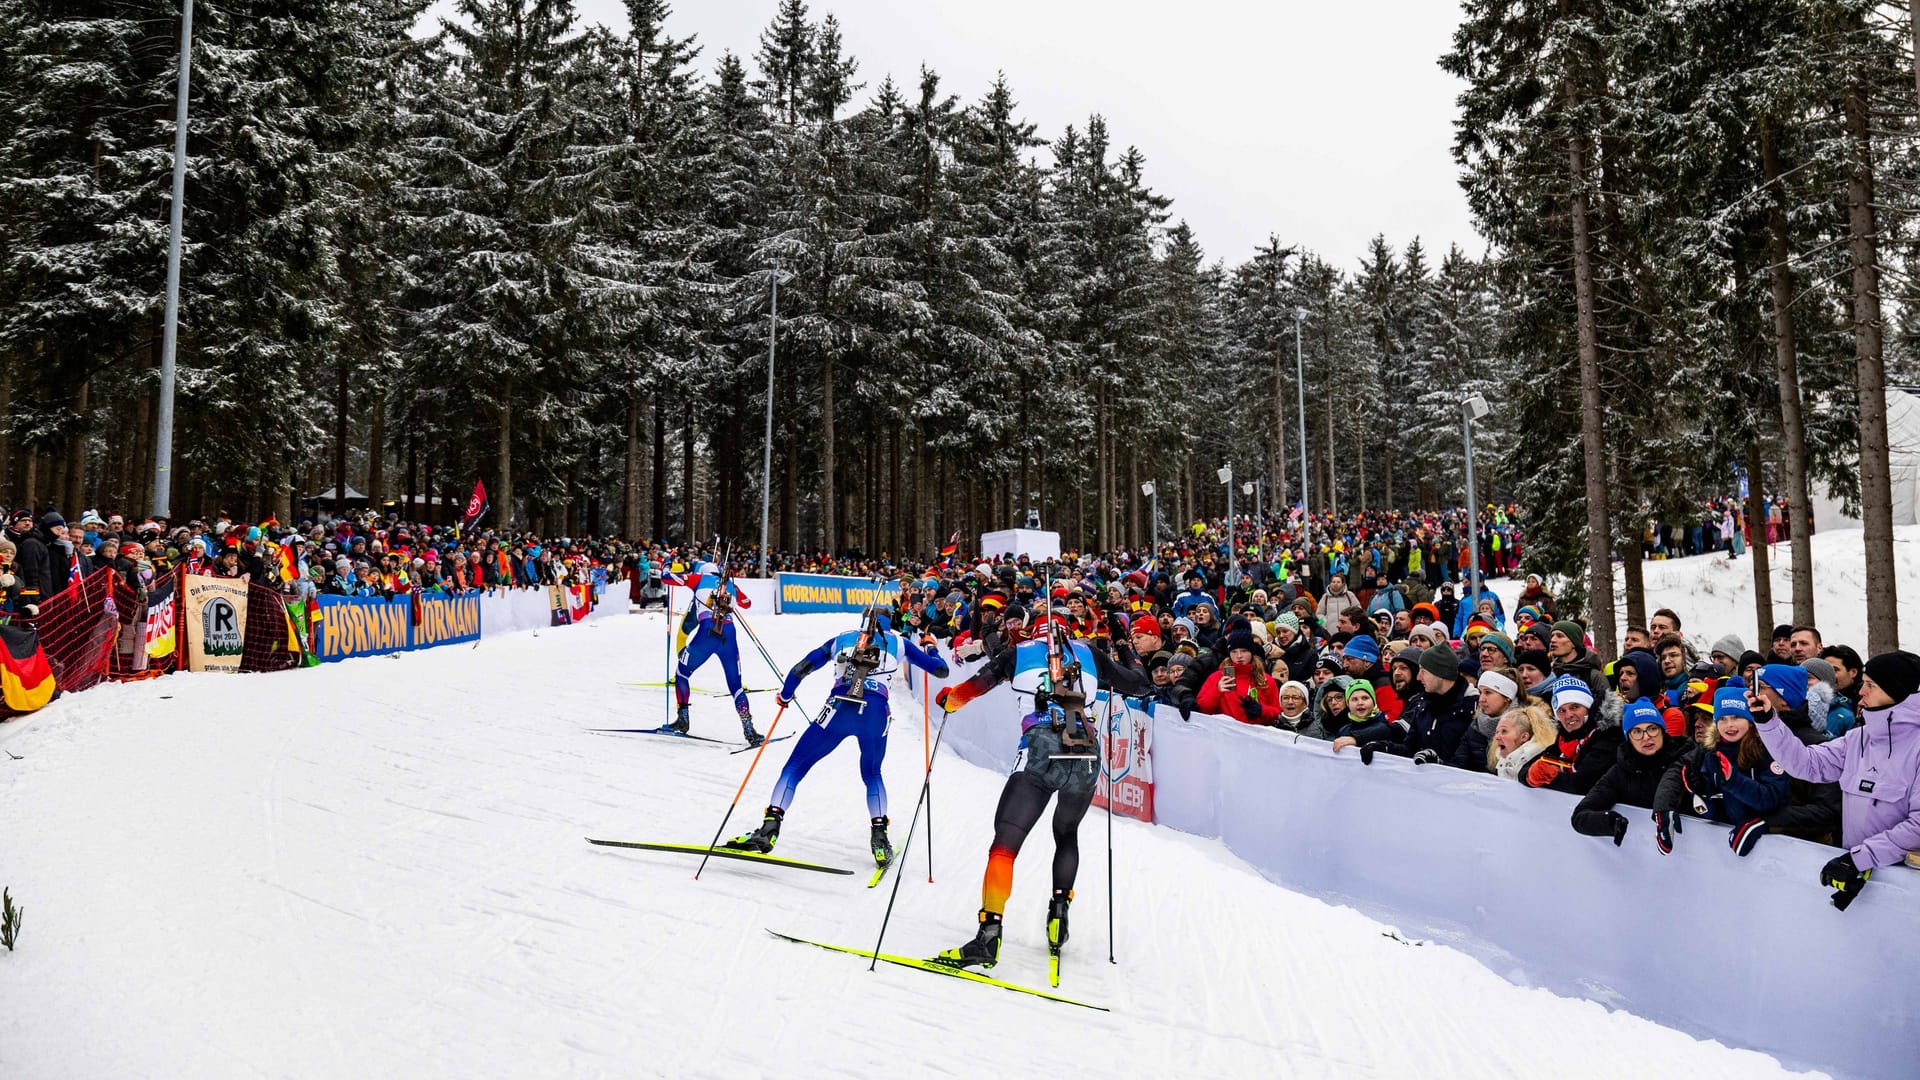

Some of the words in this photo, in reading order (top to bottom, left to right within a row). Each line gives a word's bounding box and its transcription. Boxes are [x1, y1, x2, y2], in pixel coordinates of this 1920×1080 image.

[783, 583, 842, 604] HÖRMANN
[215, 603, 233, 632] R
[323, 600, 408, 656] HÖRMANN
